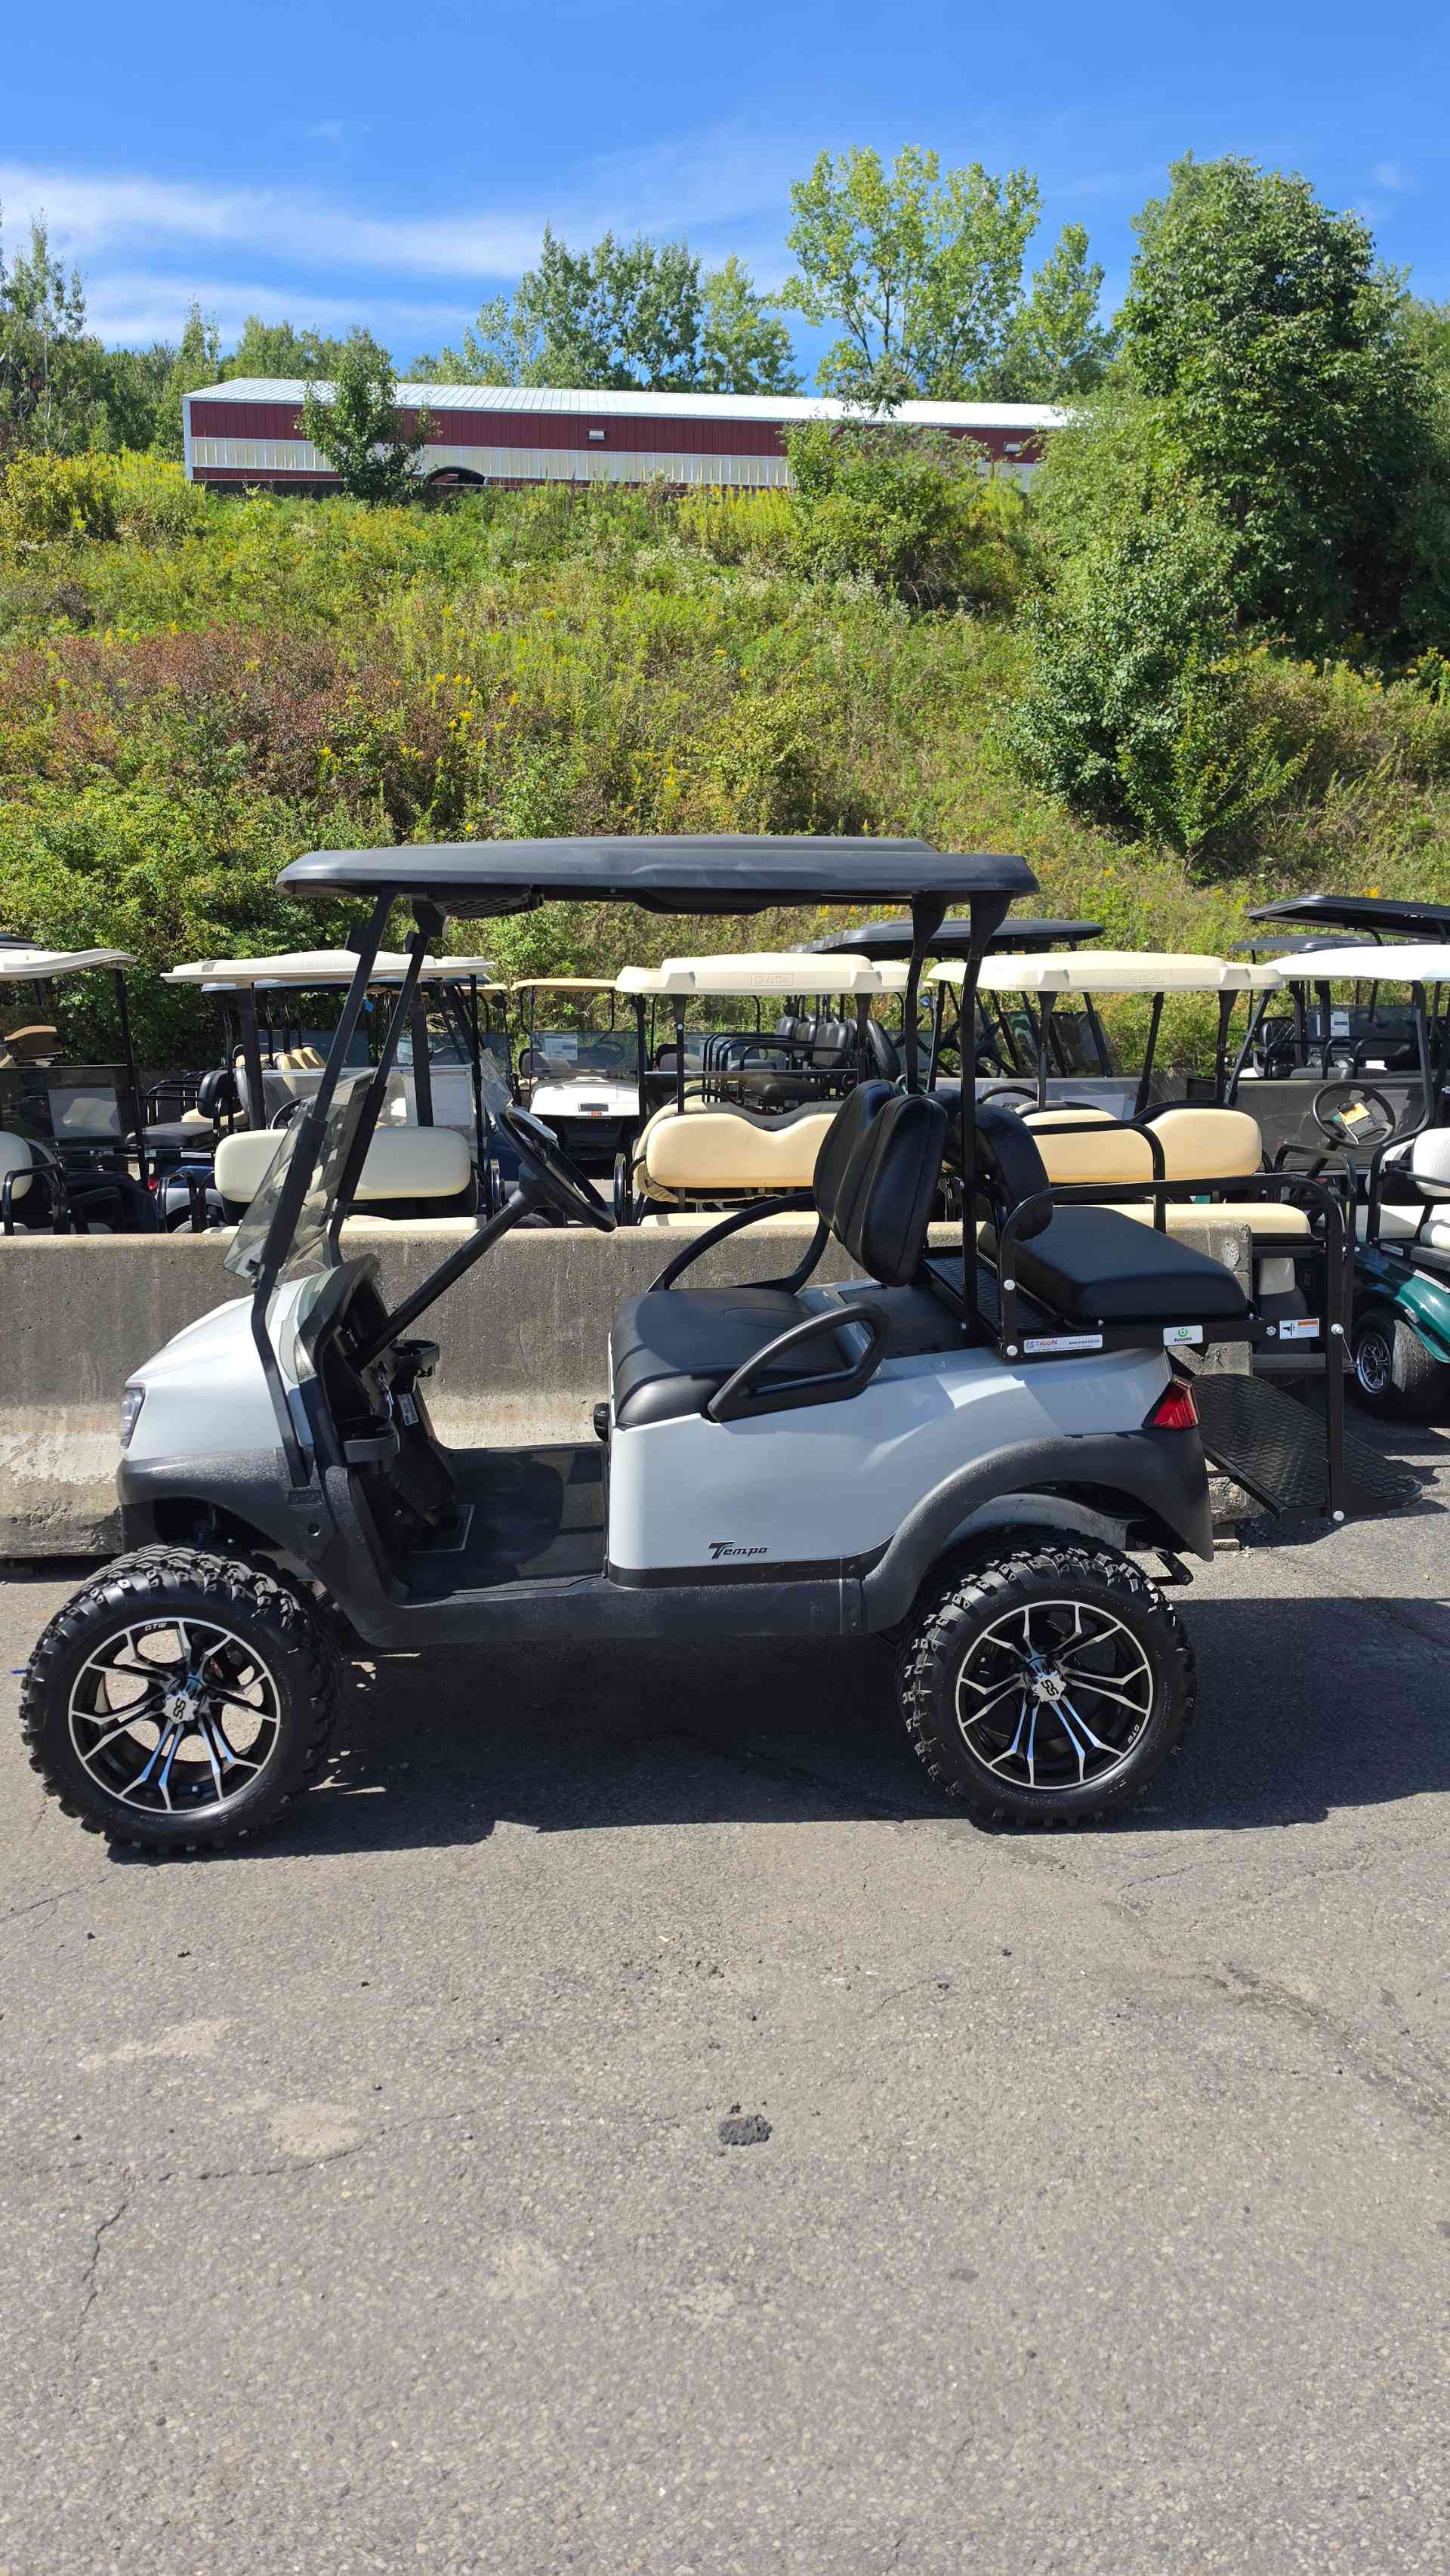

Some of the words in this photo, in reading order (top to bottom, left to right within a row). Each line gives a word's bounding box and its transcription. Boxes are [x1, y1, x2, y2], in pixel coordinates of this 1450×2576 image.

[708, 1542, 768, 1559] Tempo
[145, 1623, 166, 1631] GTW
[1128, 1724, 1140, 1744] GTW
